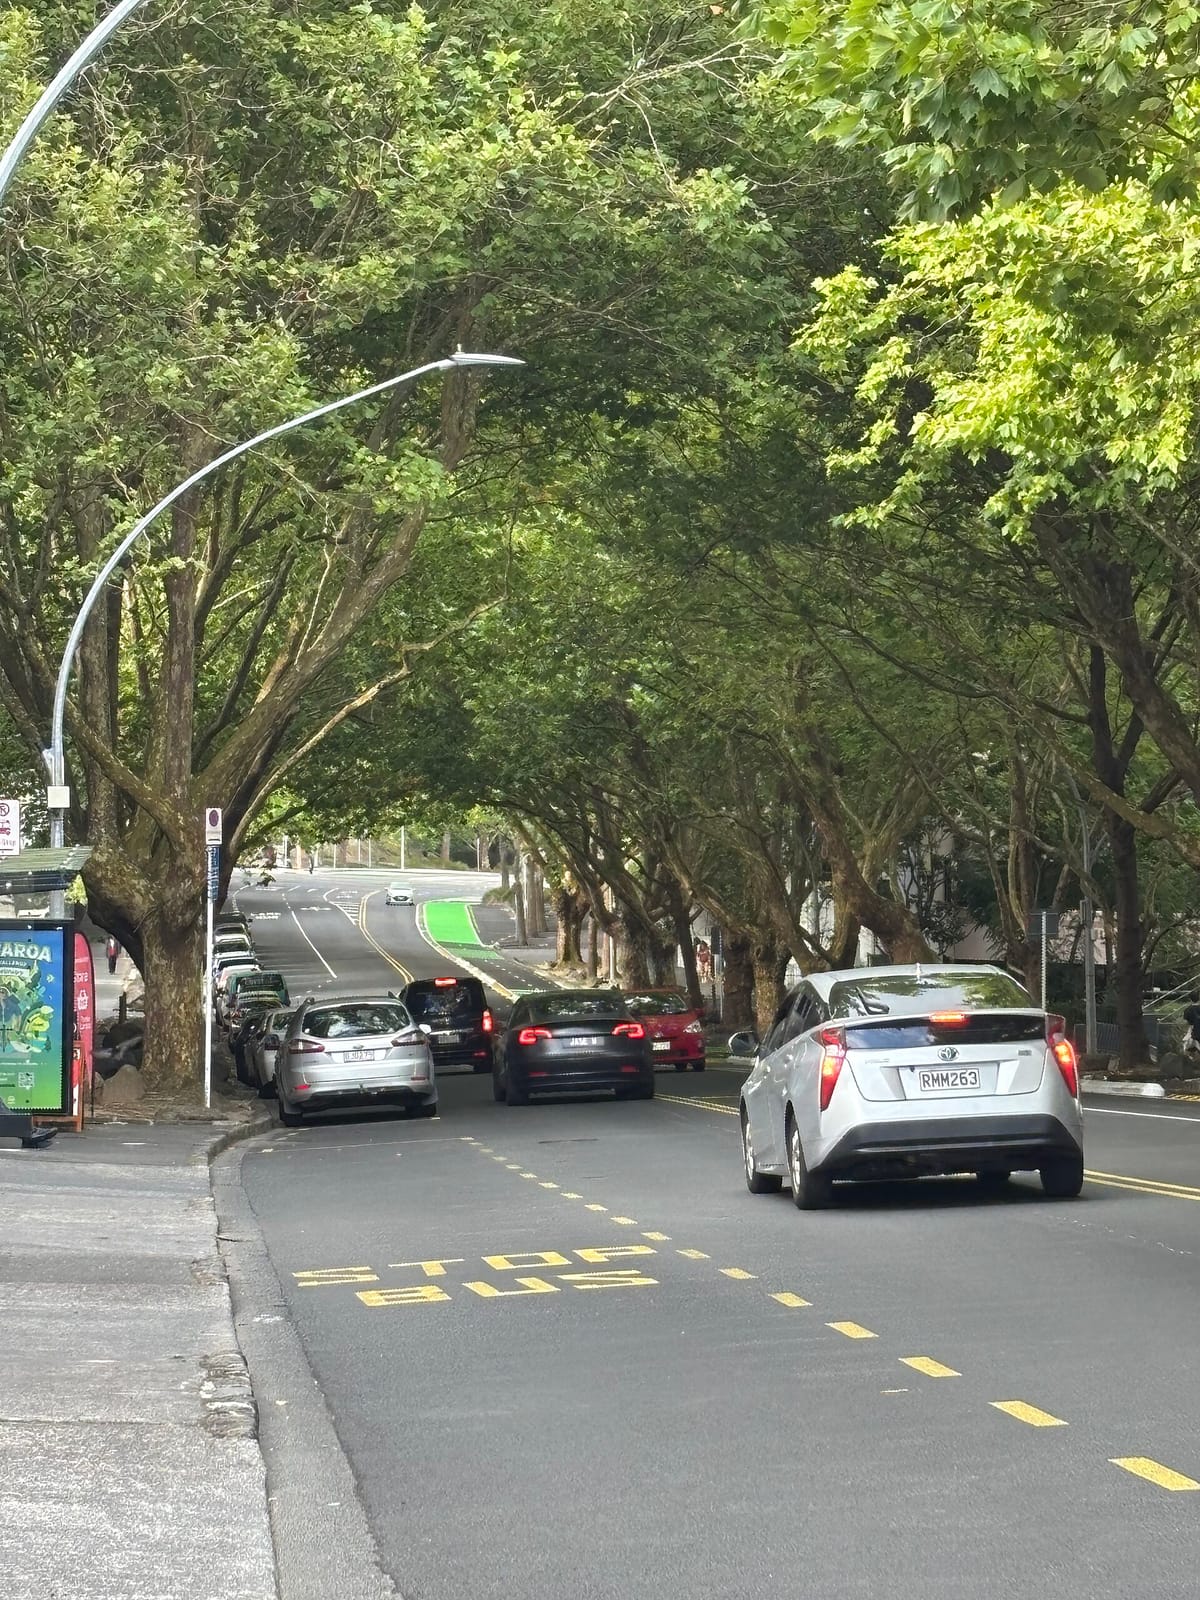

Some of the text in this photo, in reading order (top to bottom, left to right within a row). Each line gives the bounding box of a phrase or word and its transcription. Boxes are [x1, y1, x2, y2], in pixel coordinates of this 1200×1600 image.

[0, 942, 52, 963] AROA
[922, 1072, 977, 1088] RMM263
[292, 1245, 658, 1287] STOP
[355, 1269, 660, 1306] BUS
